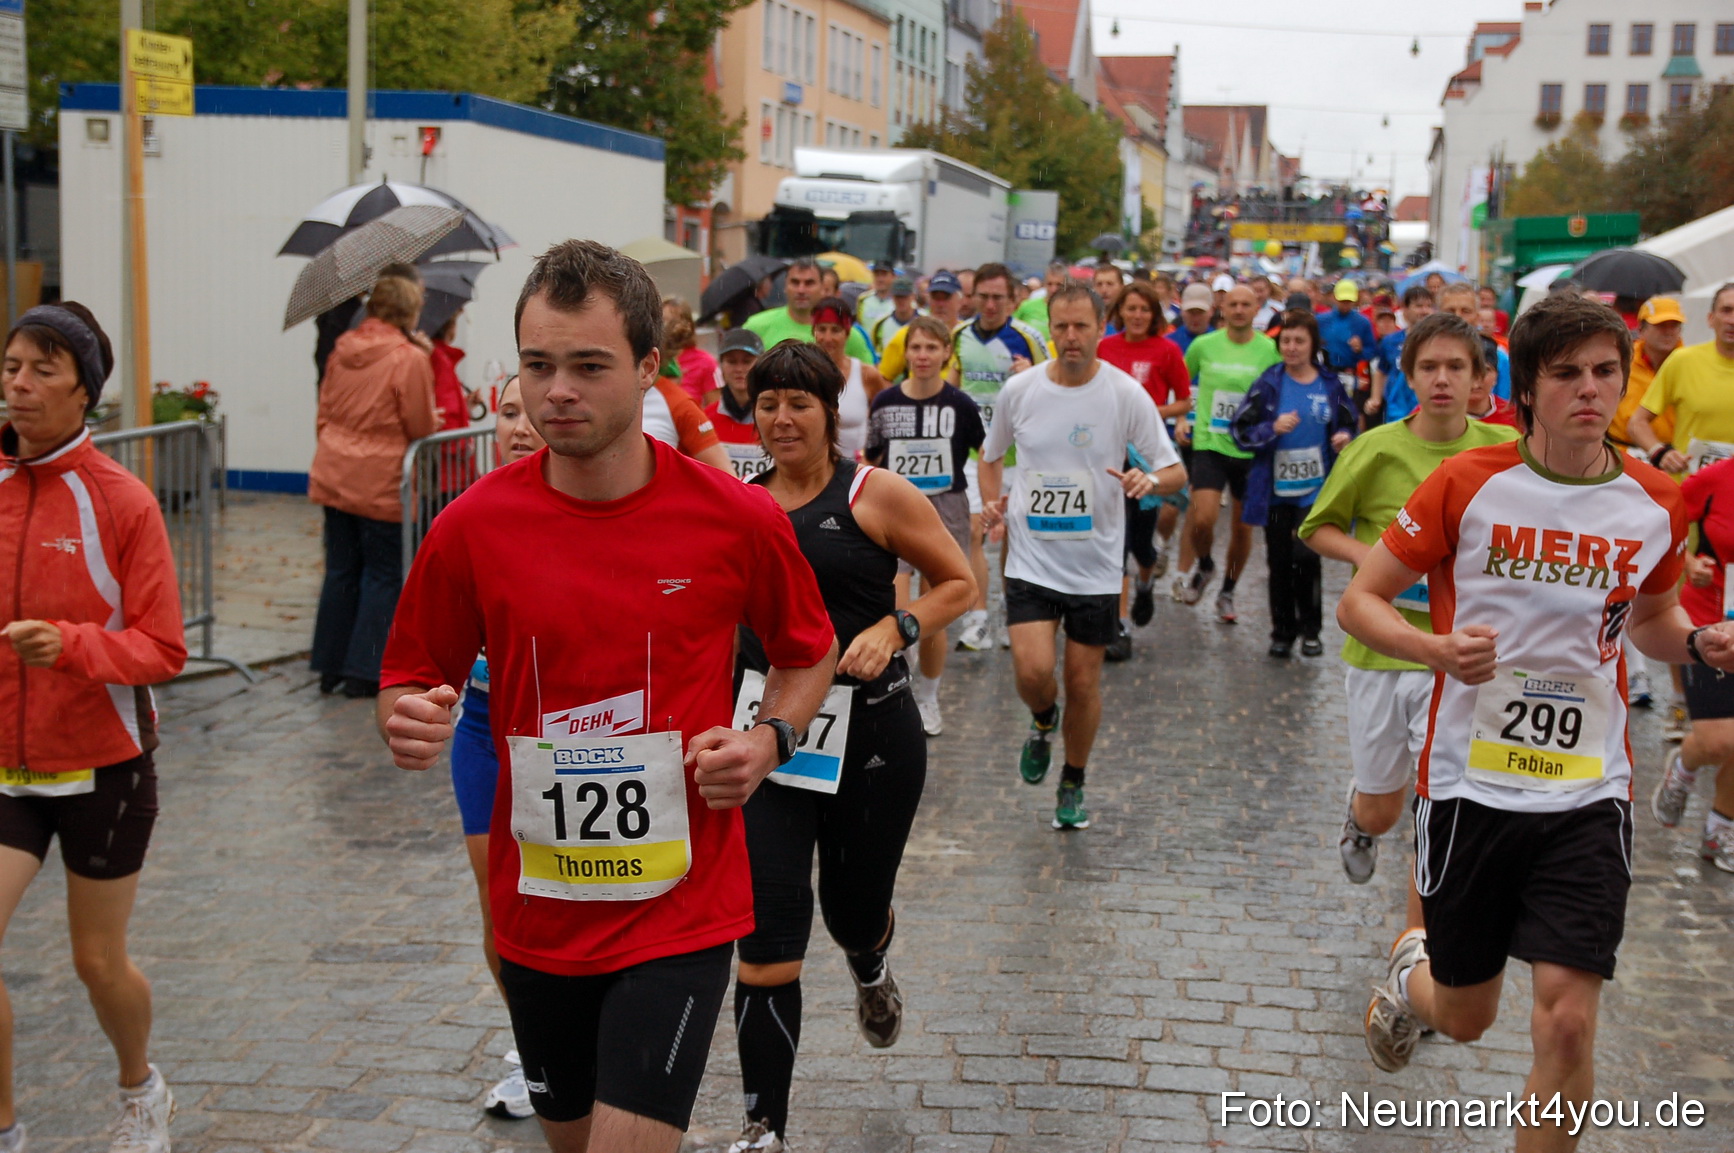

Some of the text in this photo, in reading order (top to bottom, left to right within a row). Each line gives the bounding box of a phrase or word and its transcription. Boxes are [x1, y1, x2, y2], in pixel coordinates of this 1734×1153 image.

[896, 454, 943, 475] 2271
[1279, 461, 1319, 479] 2930
[1030, 490, 1087, 514] 2274
[1491, 523, 1643, 574] MERZ
[1482, 546, 1610, 590] Reisen
[1524, 678, 1576, 694] BOCK
[568, 709, 614, 735] DEHN
[1500, 701, 1582, 749] 299
[554, 747, 624, 764] BOCK
[1507, 752, 1564, 776] Fabian
[542, 780, 650, 841] 128
[554, 853, 643, 878] Thomas
